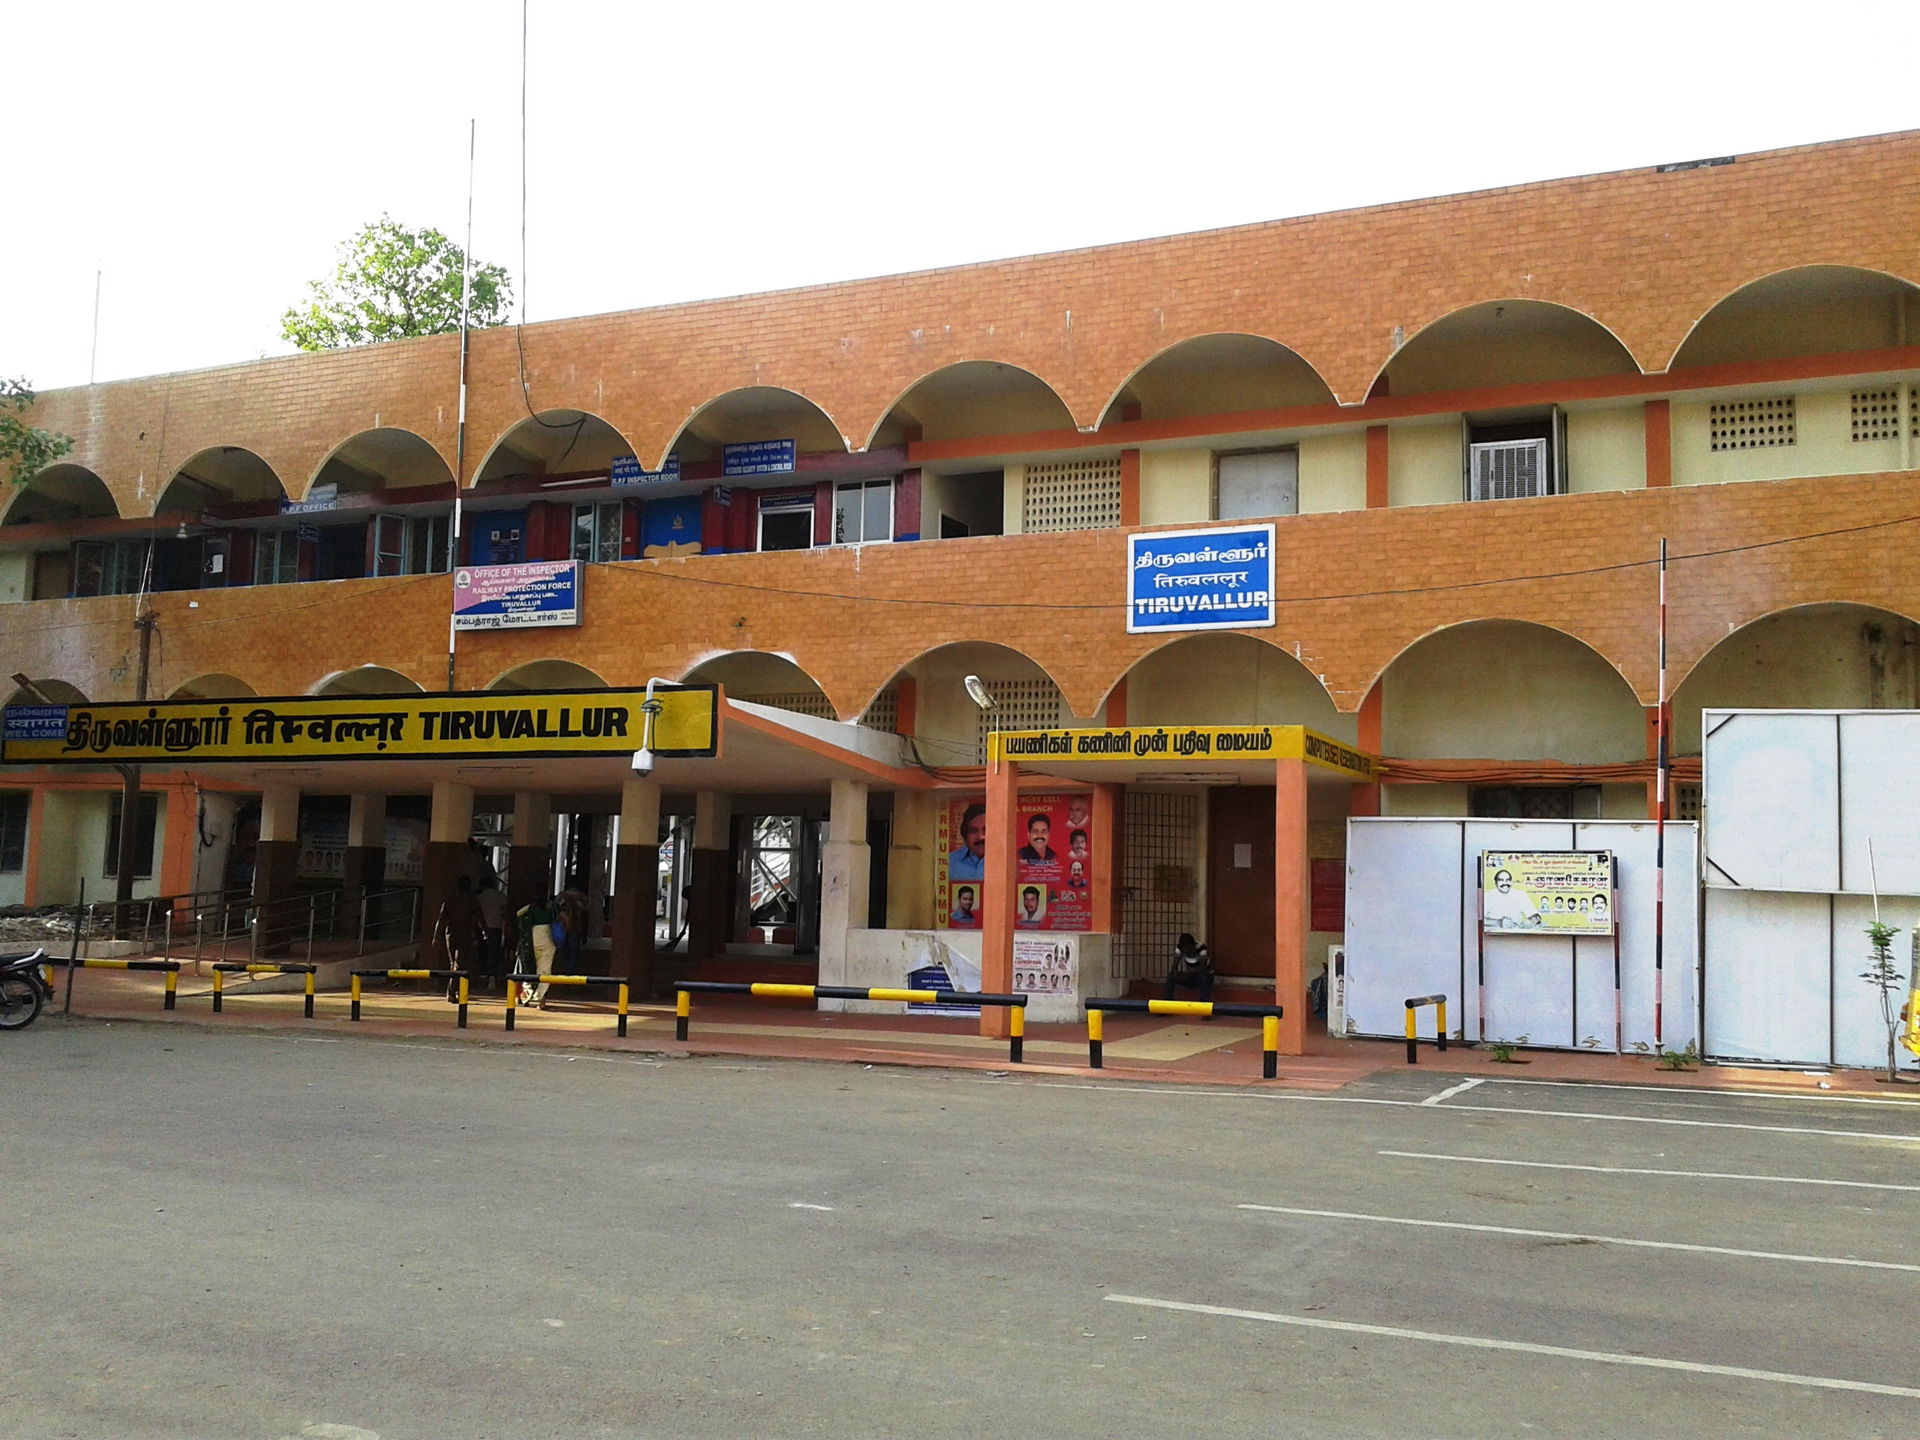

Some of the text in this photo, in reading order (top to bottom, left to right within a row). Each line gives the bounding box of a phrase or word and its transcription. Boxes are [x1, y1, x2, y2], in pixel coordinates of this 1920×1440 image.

[627, 474, 660, 484] INSPECTOR
[474, 564, 570, 578] OFFICE OF THE INSPECTOR
[472, 581, 572, 595] RAILWAY PROTECTION FORCE
[501, 599, 541, 608] TIRUVALLUR
[1134, 591, 1268, 615] TIRUVALLUR
[6, 718, 65, 729] स्वागत
[418, 707, 629, 741] TIRUVALLUR
[1006, 727, 1272, 757] பயணிகள் கணினி முன் பதிவு மையம்
